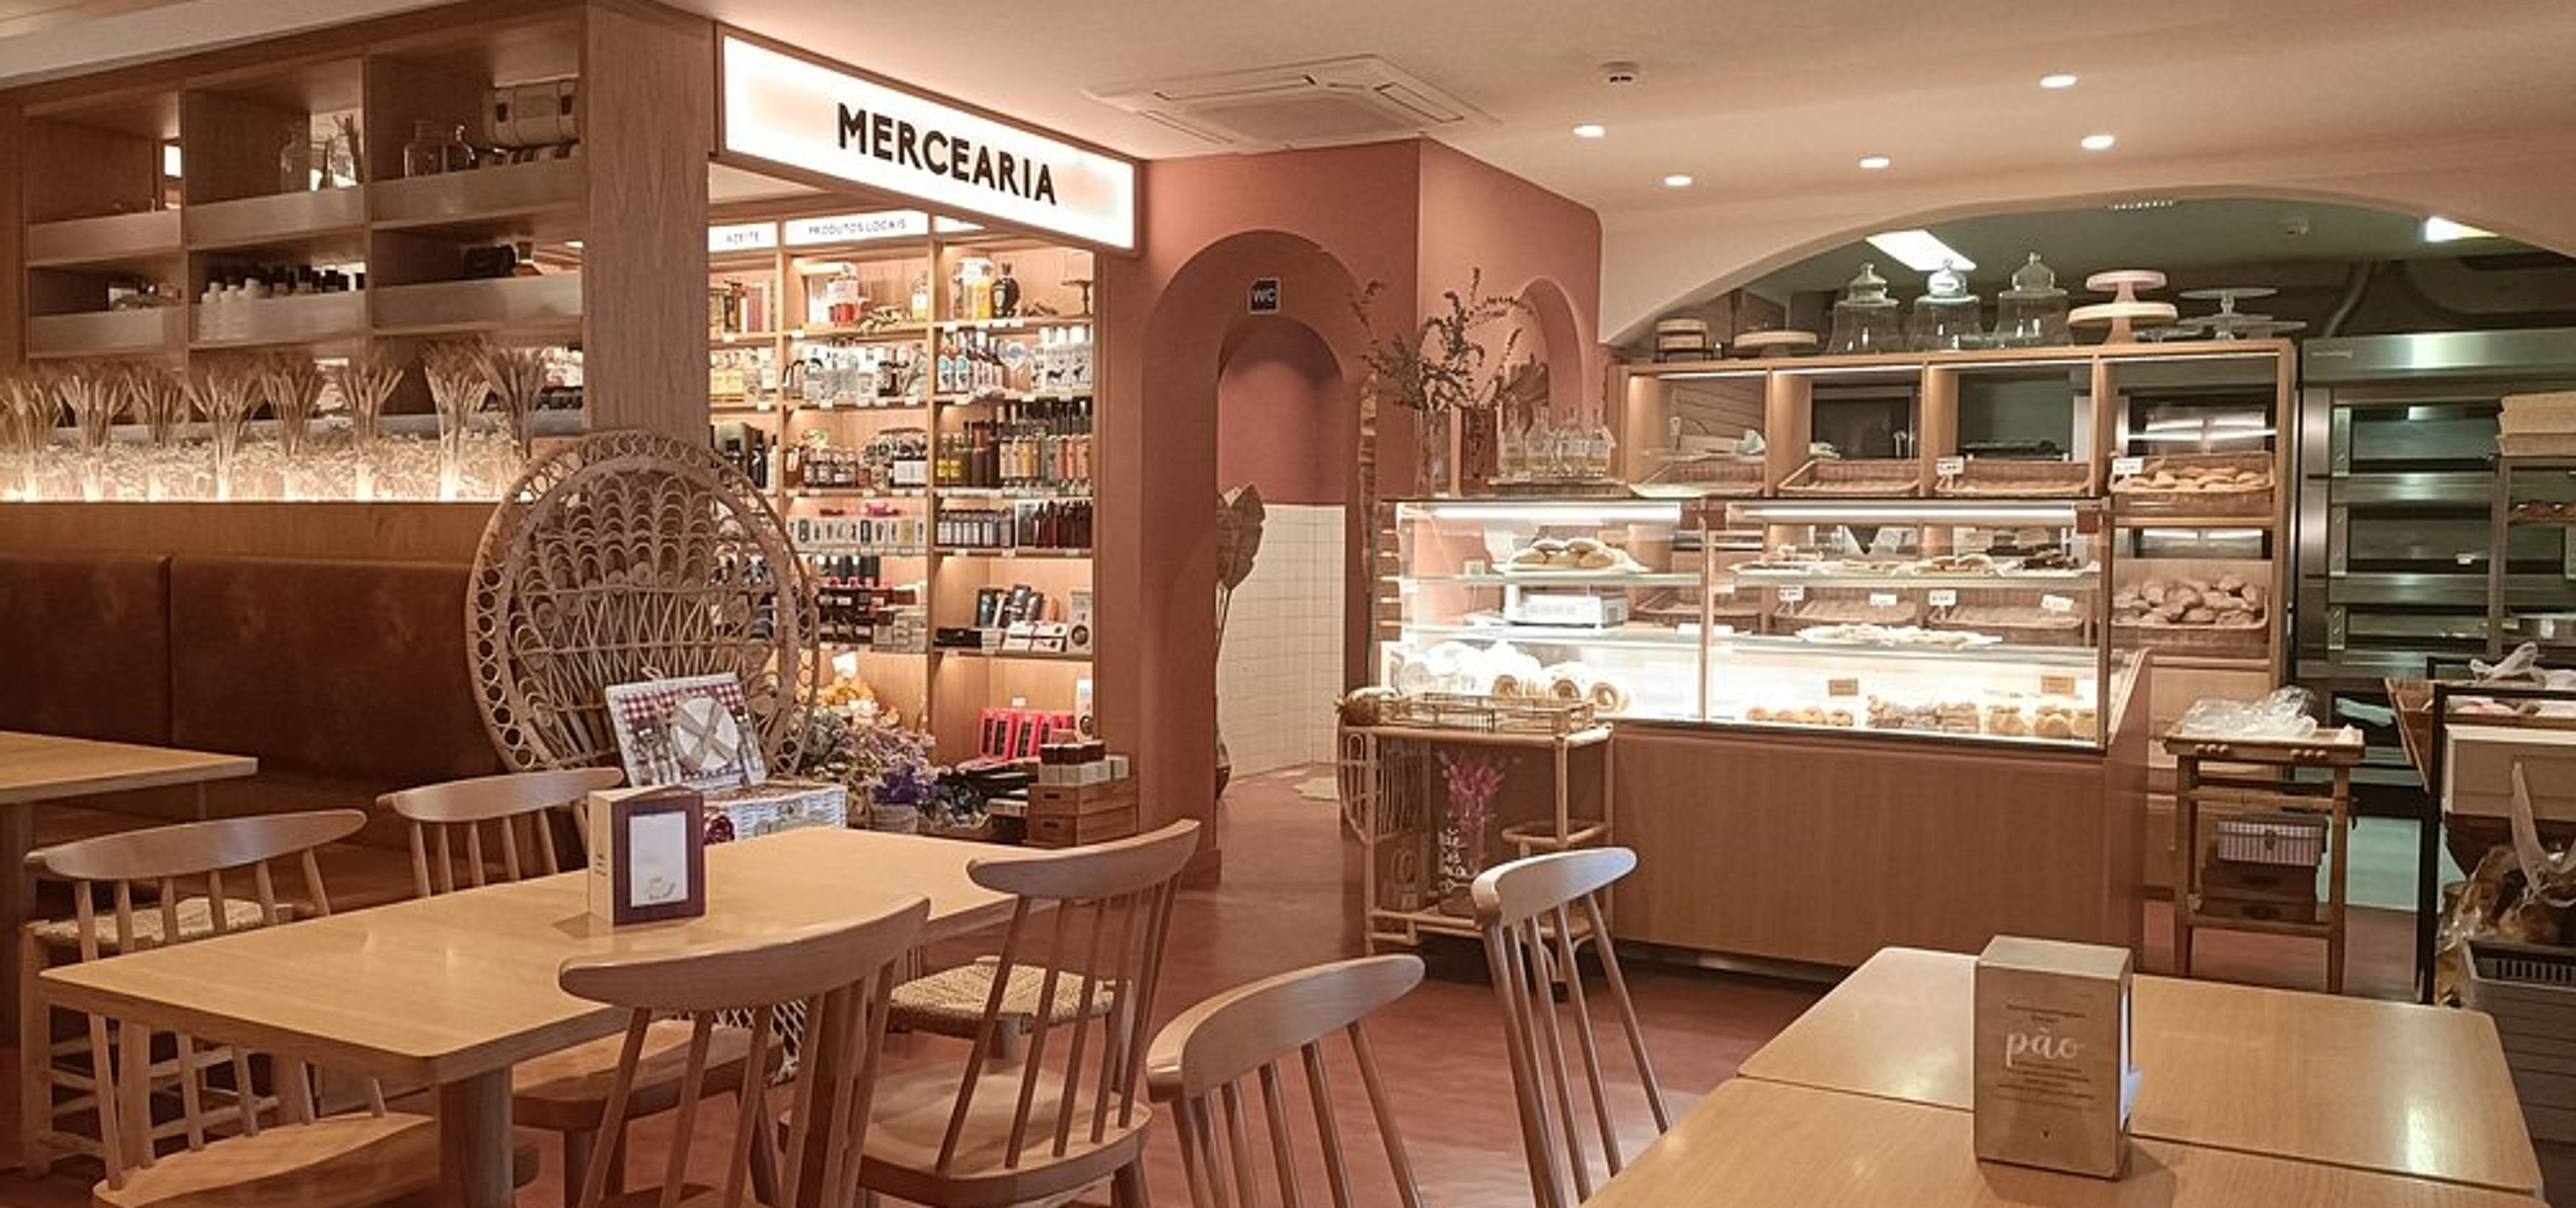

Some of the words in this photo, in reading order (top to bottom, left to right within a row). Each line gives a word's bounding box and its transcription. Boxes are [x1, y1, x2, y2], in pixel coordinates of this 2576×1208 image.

[838, 102, 1057, 206] MERCEARIA
[808, 222, 864, 235] PRODUTOS
[866, 218, 906, 233] LOCAIS
[726, 231, 760, 244] AZEITE
[1252, 288, 1277, 302] WC
[2006, 1026, 2080, 1067] pão
